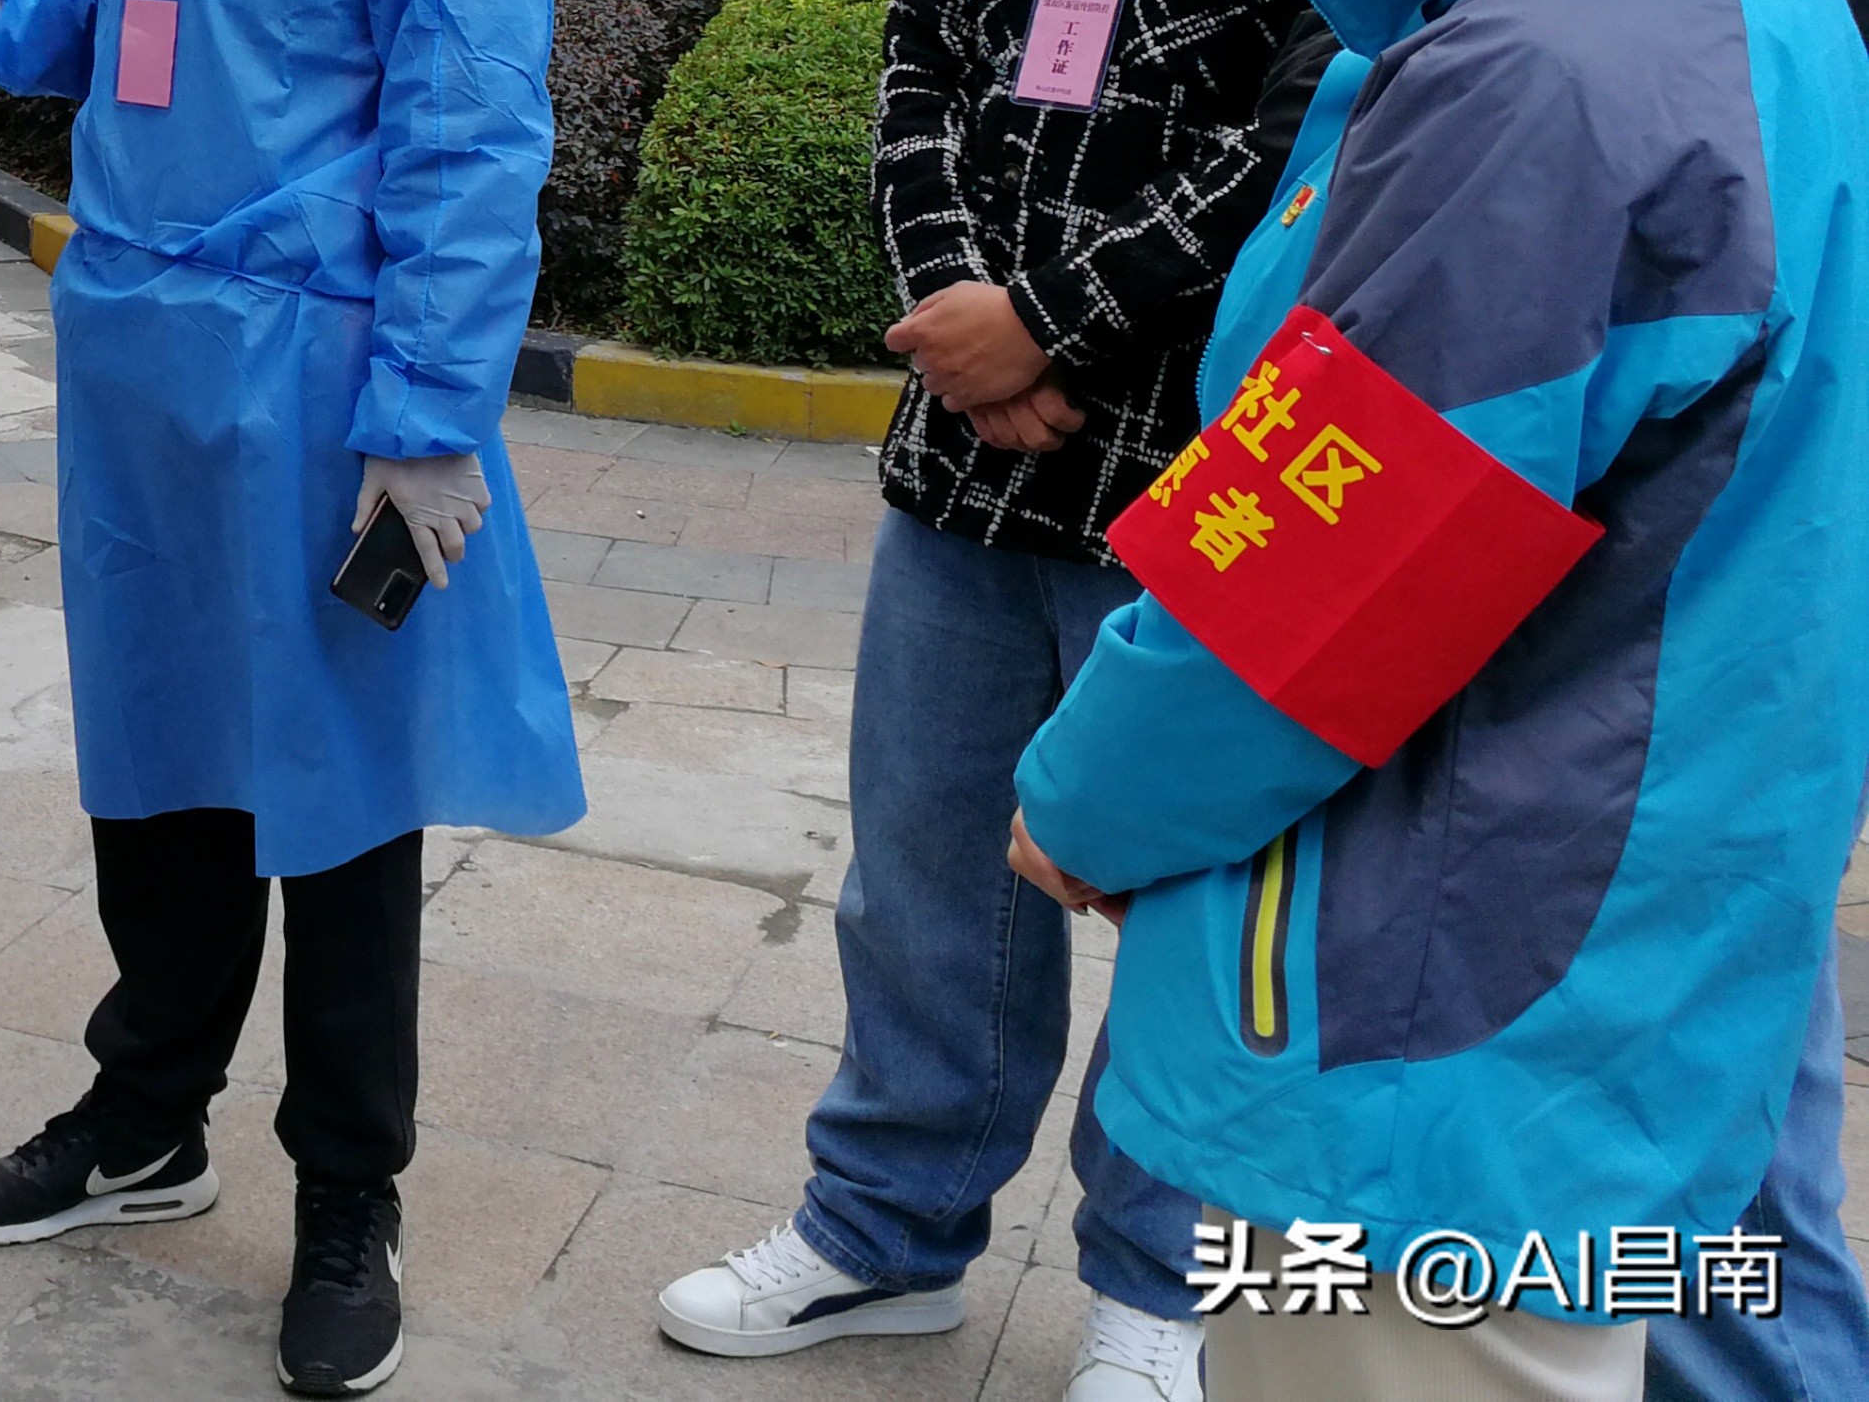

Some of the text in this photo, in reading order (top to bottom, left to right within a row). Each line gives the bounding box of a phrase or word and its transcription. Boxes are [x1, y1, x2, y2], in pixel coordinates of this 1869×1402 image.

[1051, 21, 1081, 75] 工作证
[1220, 360, 1383, 525] 社区
